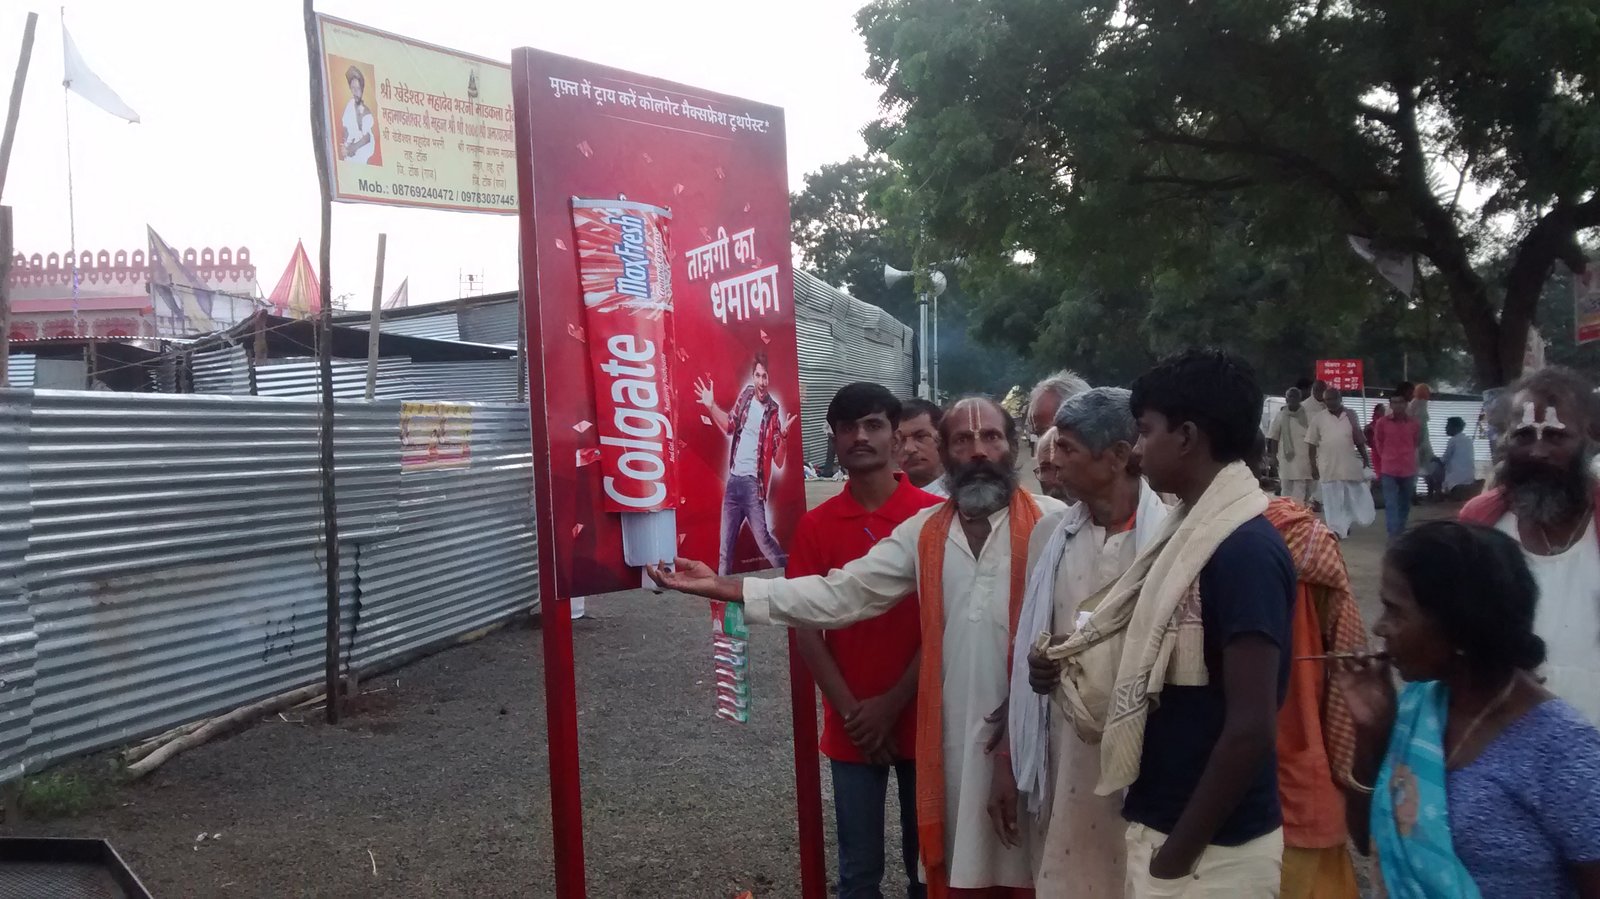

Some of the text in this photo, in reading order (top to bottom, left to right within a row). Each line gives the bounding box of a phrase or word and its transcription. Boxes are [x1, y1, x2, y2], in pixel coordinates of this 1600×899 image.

[381, 78, 391, 99] श्री
[427, 92, 452, 112] महादेव
[581, 79, 591, 99] में
[594, 86, 616, 106] ट्राय
[618, 88, 637, 109] करें
[639, 93, 680, 117] कोलगेट
[682, 100, 727, 126] मैक्सफ्रेश
[392, 183, 455, 201] 08769240472
[609, 214, 651, 299] MaxFresh
[685, 226, 729, 280] ताज़गी
[732, 228, 755, 263] का
[710, 264, 780, 324] धमाका
[600, 334, 673, 508] Colgate
